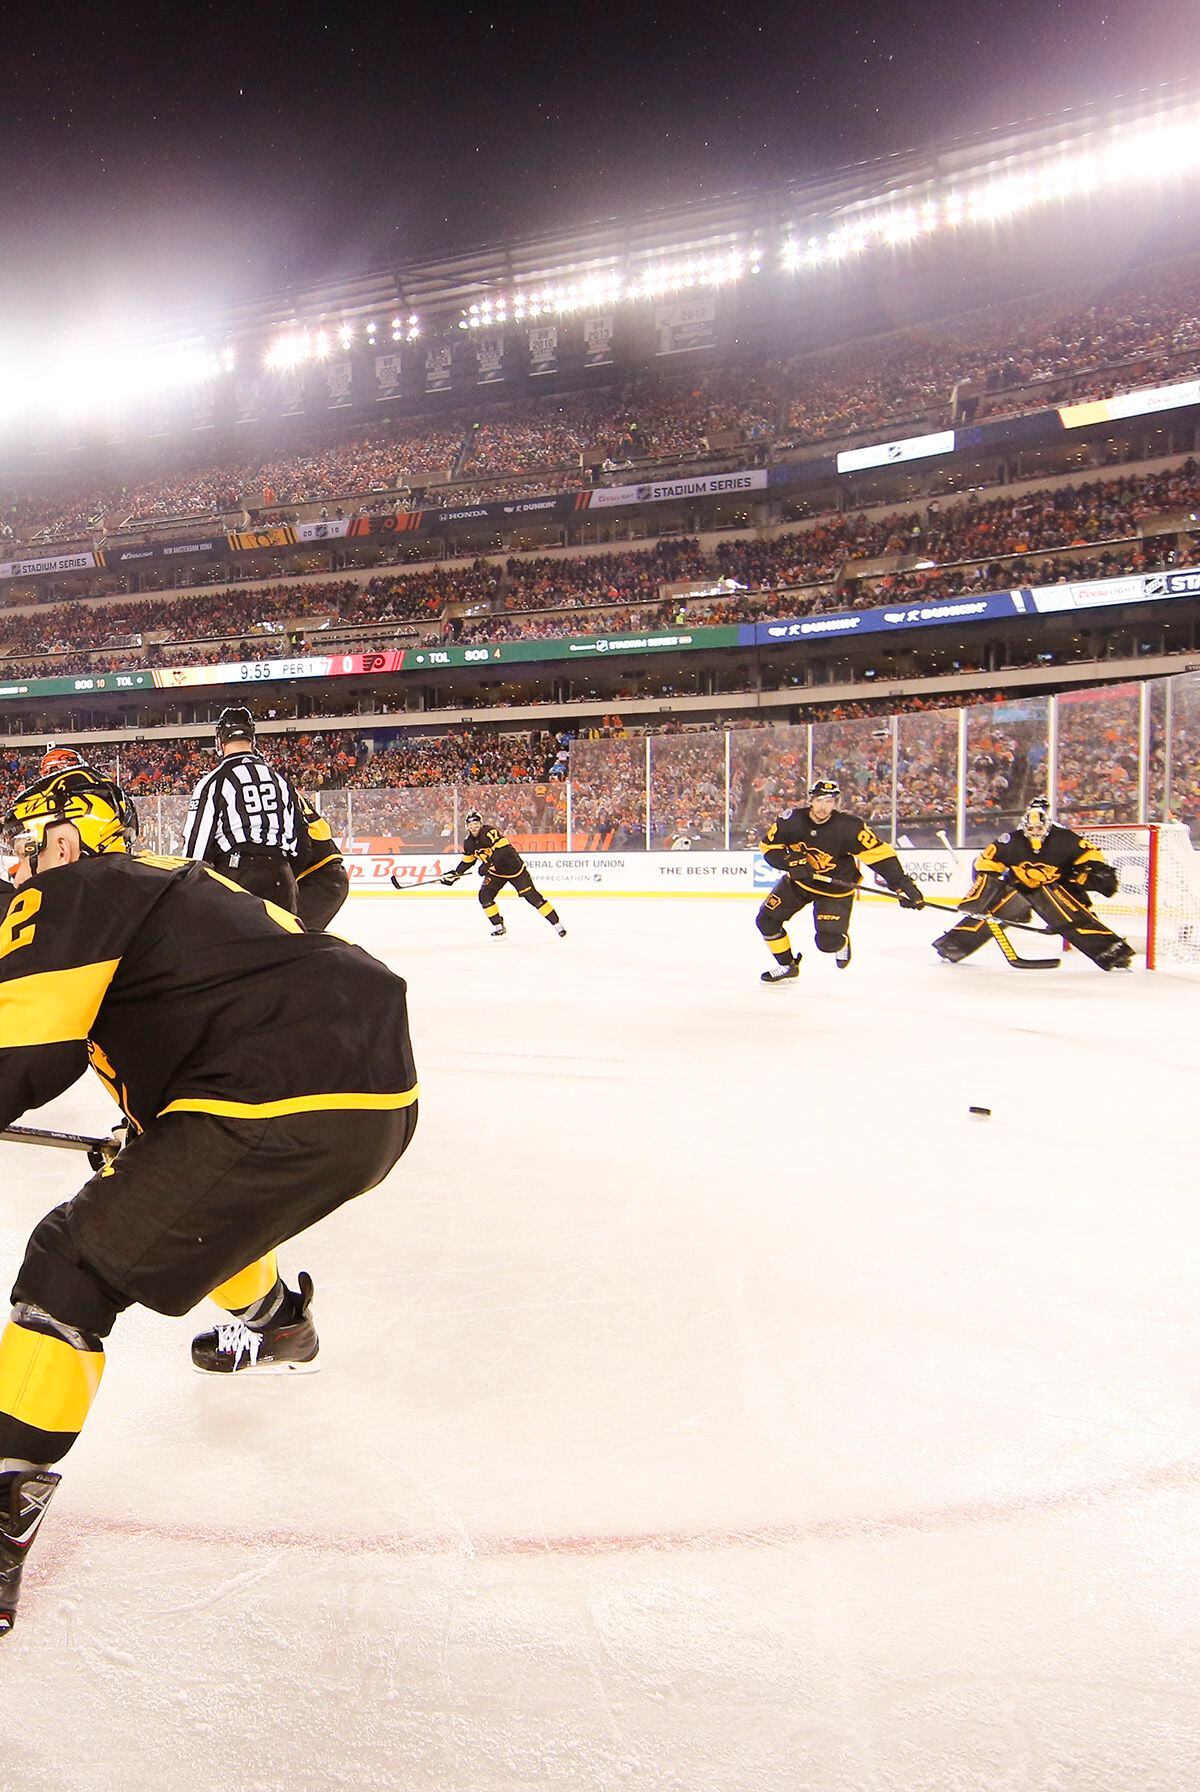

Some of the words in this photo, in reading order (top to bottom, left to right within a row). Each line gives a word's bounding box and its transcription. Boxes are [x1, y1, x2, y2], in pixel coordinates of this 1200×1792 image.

[653, 482, 706, 498] STADIUM
[710, 477, 752, 491] SERIES
[449, 510, 489, 520] HONDA
[22, 561, 58, 574] STADIUM
[59, 557, 87, 569] SERIES
[428, 652, 451, 664] TOL
[464, 648, 489, 661] SOG
[493, 648, 501, 659] 4
[240, 664, 271, 680] 9:55
[283, 664, 305, 675] PER
[74, 679, 94, 690] SOG
[95, 678, 105, 689] 10
[115, 676, 134, 687] TOL
[242, 783, 278, 813] 92
[188, 800, 199, 811] 92
[525, 859, 554, 869] DERAL
[555, 859, 590, 869] CREDIT
[593, 859, 625, 868] UNION
[933, 861, 948, 872] OF
[371, 858, 442, 884] Boys
[659, 867, 682, 875] THE
[686, 867, 716, 876] BEST
[721, 867, 748, 876] RUN
[909, 872, 953, 883] OCKEY
[817, 914, 841, 922] CCM
